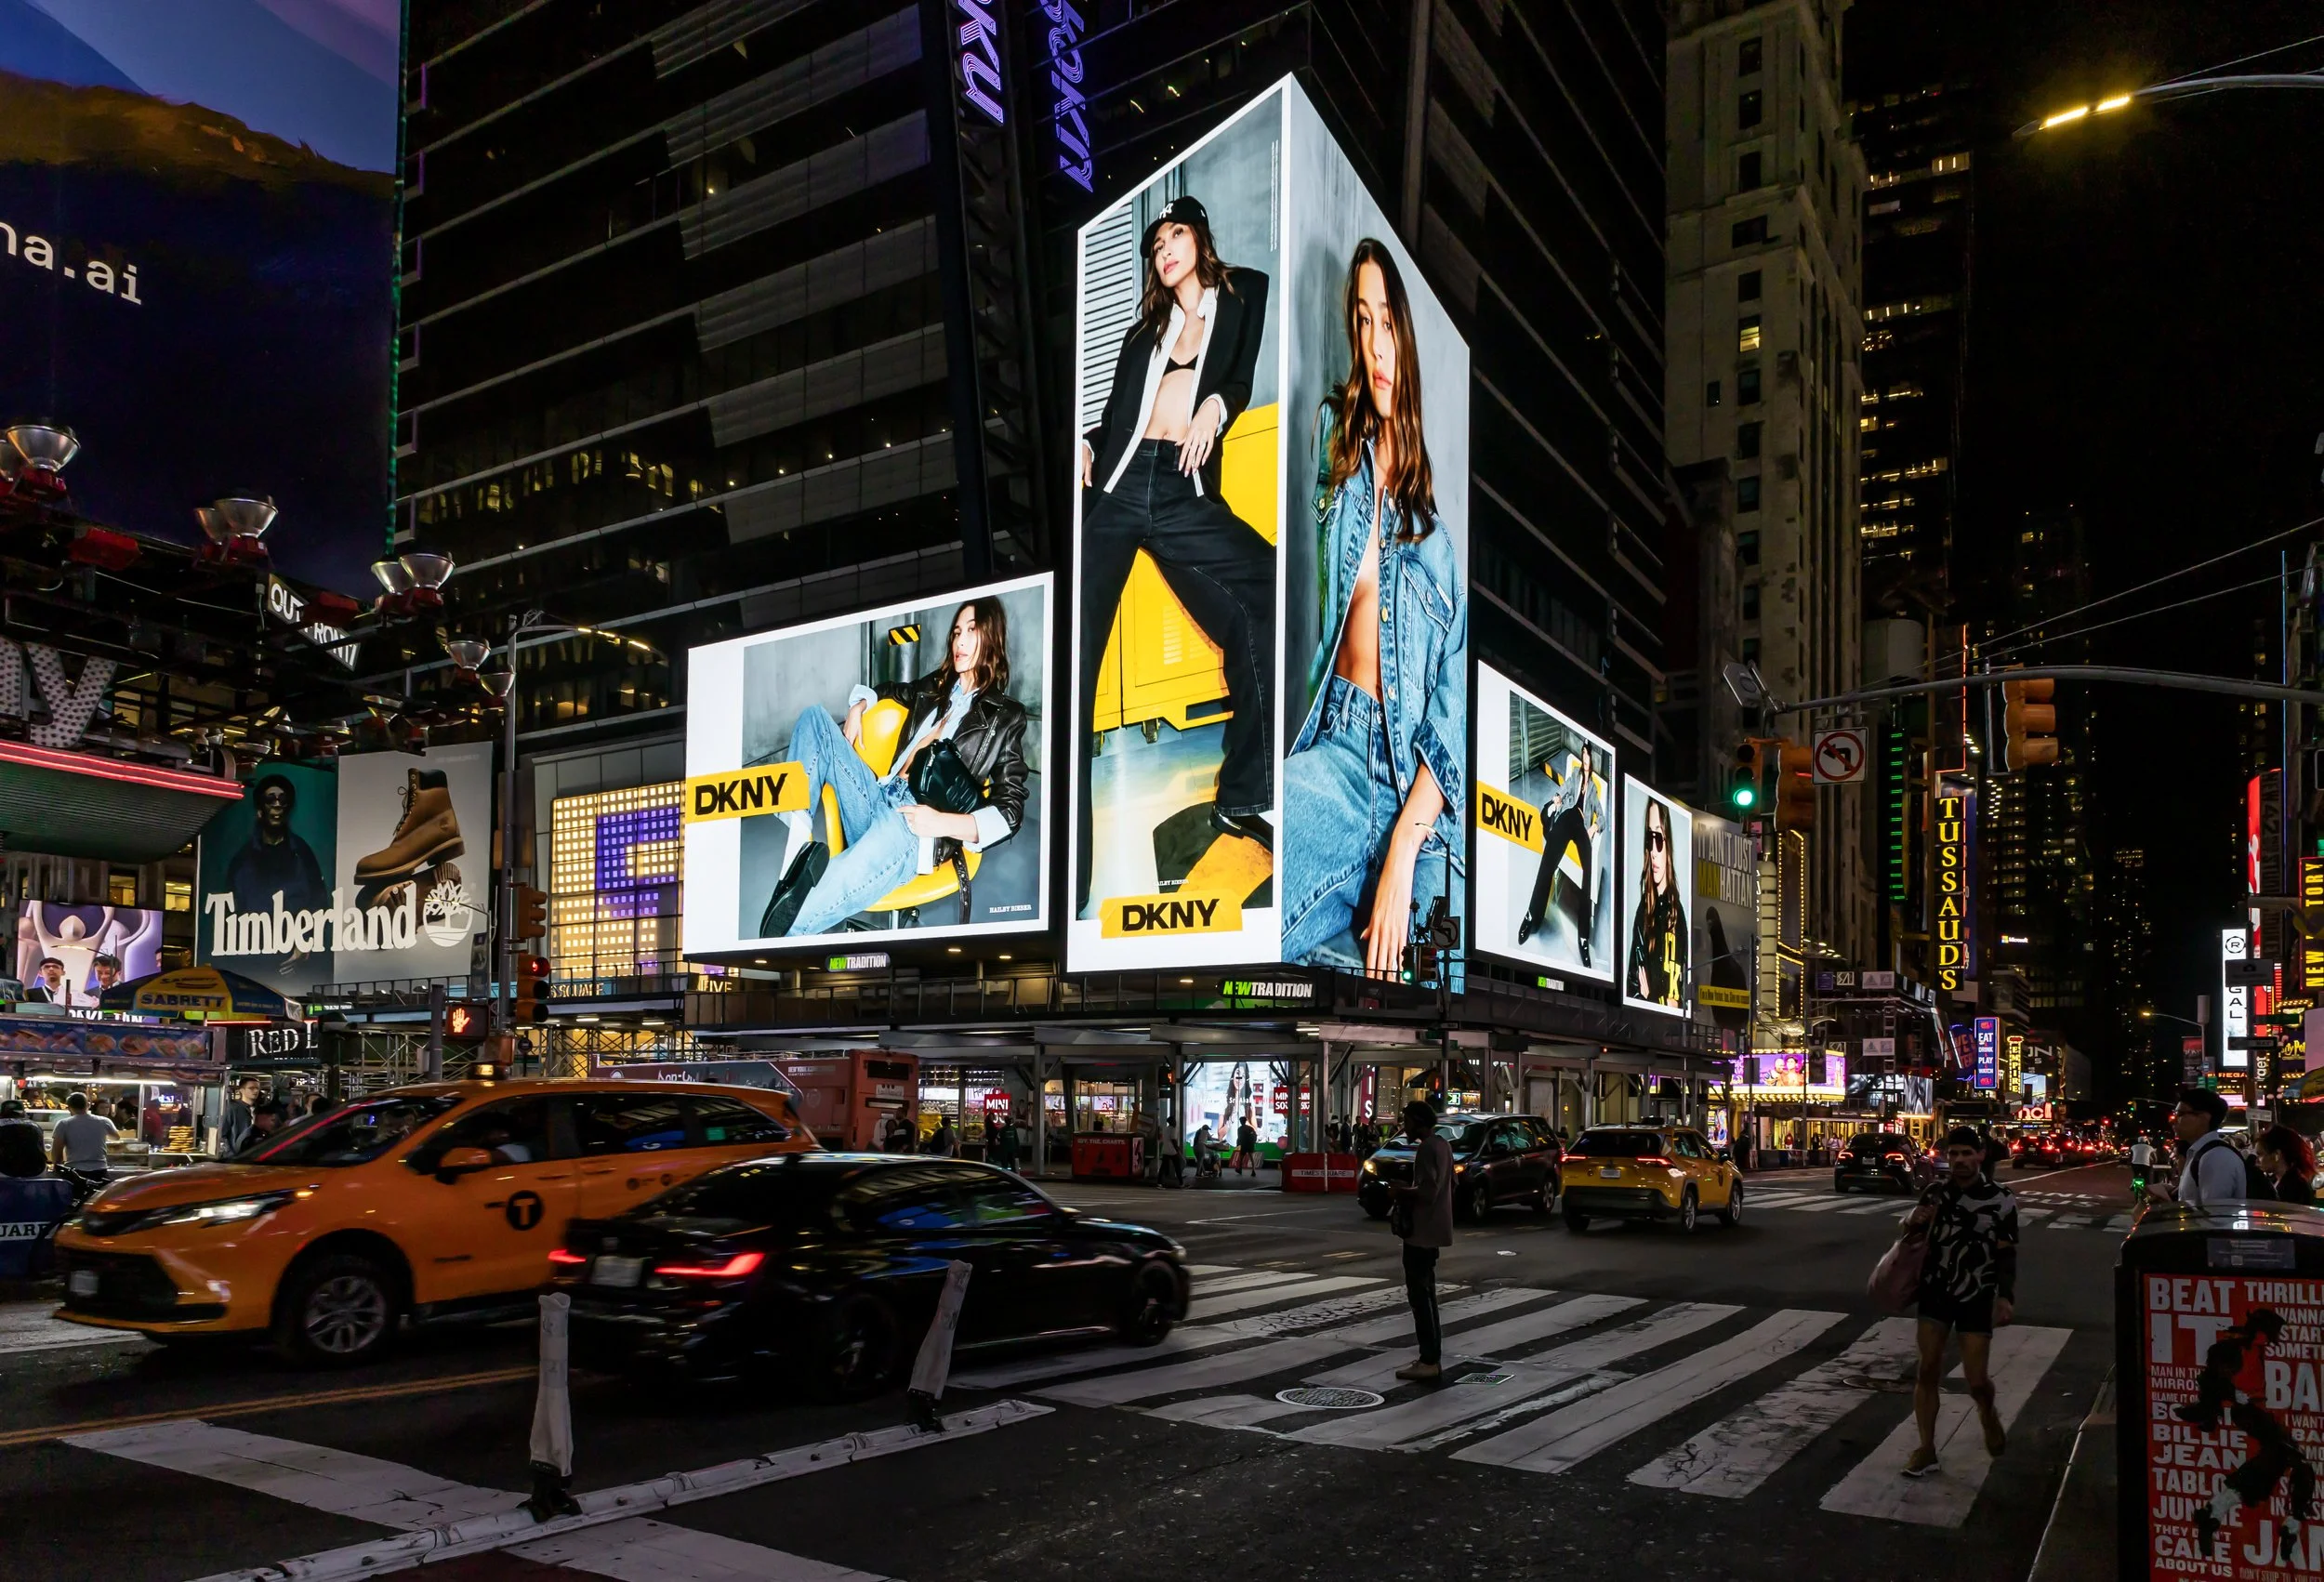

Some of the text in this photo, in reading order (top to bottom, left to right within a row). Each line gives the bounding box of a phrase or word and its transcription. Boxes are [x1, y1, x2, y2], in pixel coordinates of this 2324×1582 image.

[695, 773, 788, 815] DKNY
[1482, 792, 1533, 842] DKNY
[1697, 823, 1752, 874] IT AIN'T JUST
[1697, 861, 1752, 908] MANHATTAN
[1938, 798, 1961, 990] TUSSAUD'S
[205, 880, 417, 956] Timberland
[1122, 899, 1220, 932] DKNY
[2305, 950, 2324, 987] NEW
[141, 994, 226, 1008] SABRETT
[248, 1029, 298, 1058] RED
[1978, 1033, 1993, 1042] EAT
[2011, 1045, 2021, 1093] EMPIRE
[986, 1099, 1009, 1110] MINI
[1274, 1092, 1288, 1101] MIN
[513, 1197, 536, 1226] T
[2149, 1277, 2236, 1313] BEAT
[2244, 1281, 2324, 1306] THRILL
[2151, 1312, 2234, 1366] IT
[2264, 1341, 2324, 1360] SOMET
[2151, 1364, 2205, 1379] MAN IN TH
[2151, 1391, 2179, 1403] BLAME
[2180, 1393, 2187, 1404] IT
[2264, 1360, 2324, 1413] BA
[2152, 1423, 2248, 1449] BILLIE
[2291, 1428, 2324, 1444] BA
[2152, 1443, 2247, 1470] JEAN
[2152, 1467, 2228, 1496] TABLO
[2152, 1495, 2243, 1528] JUNIE
[2153, 1523, 2188, 1536] THEY
[2154, 1556, 2233, 1578] ABOUT US
